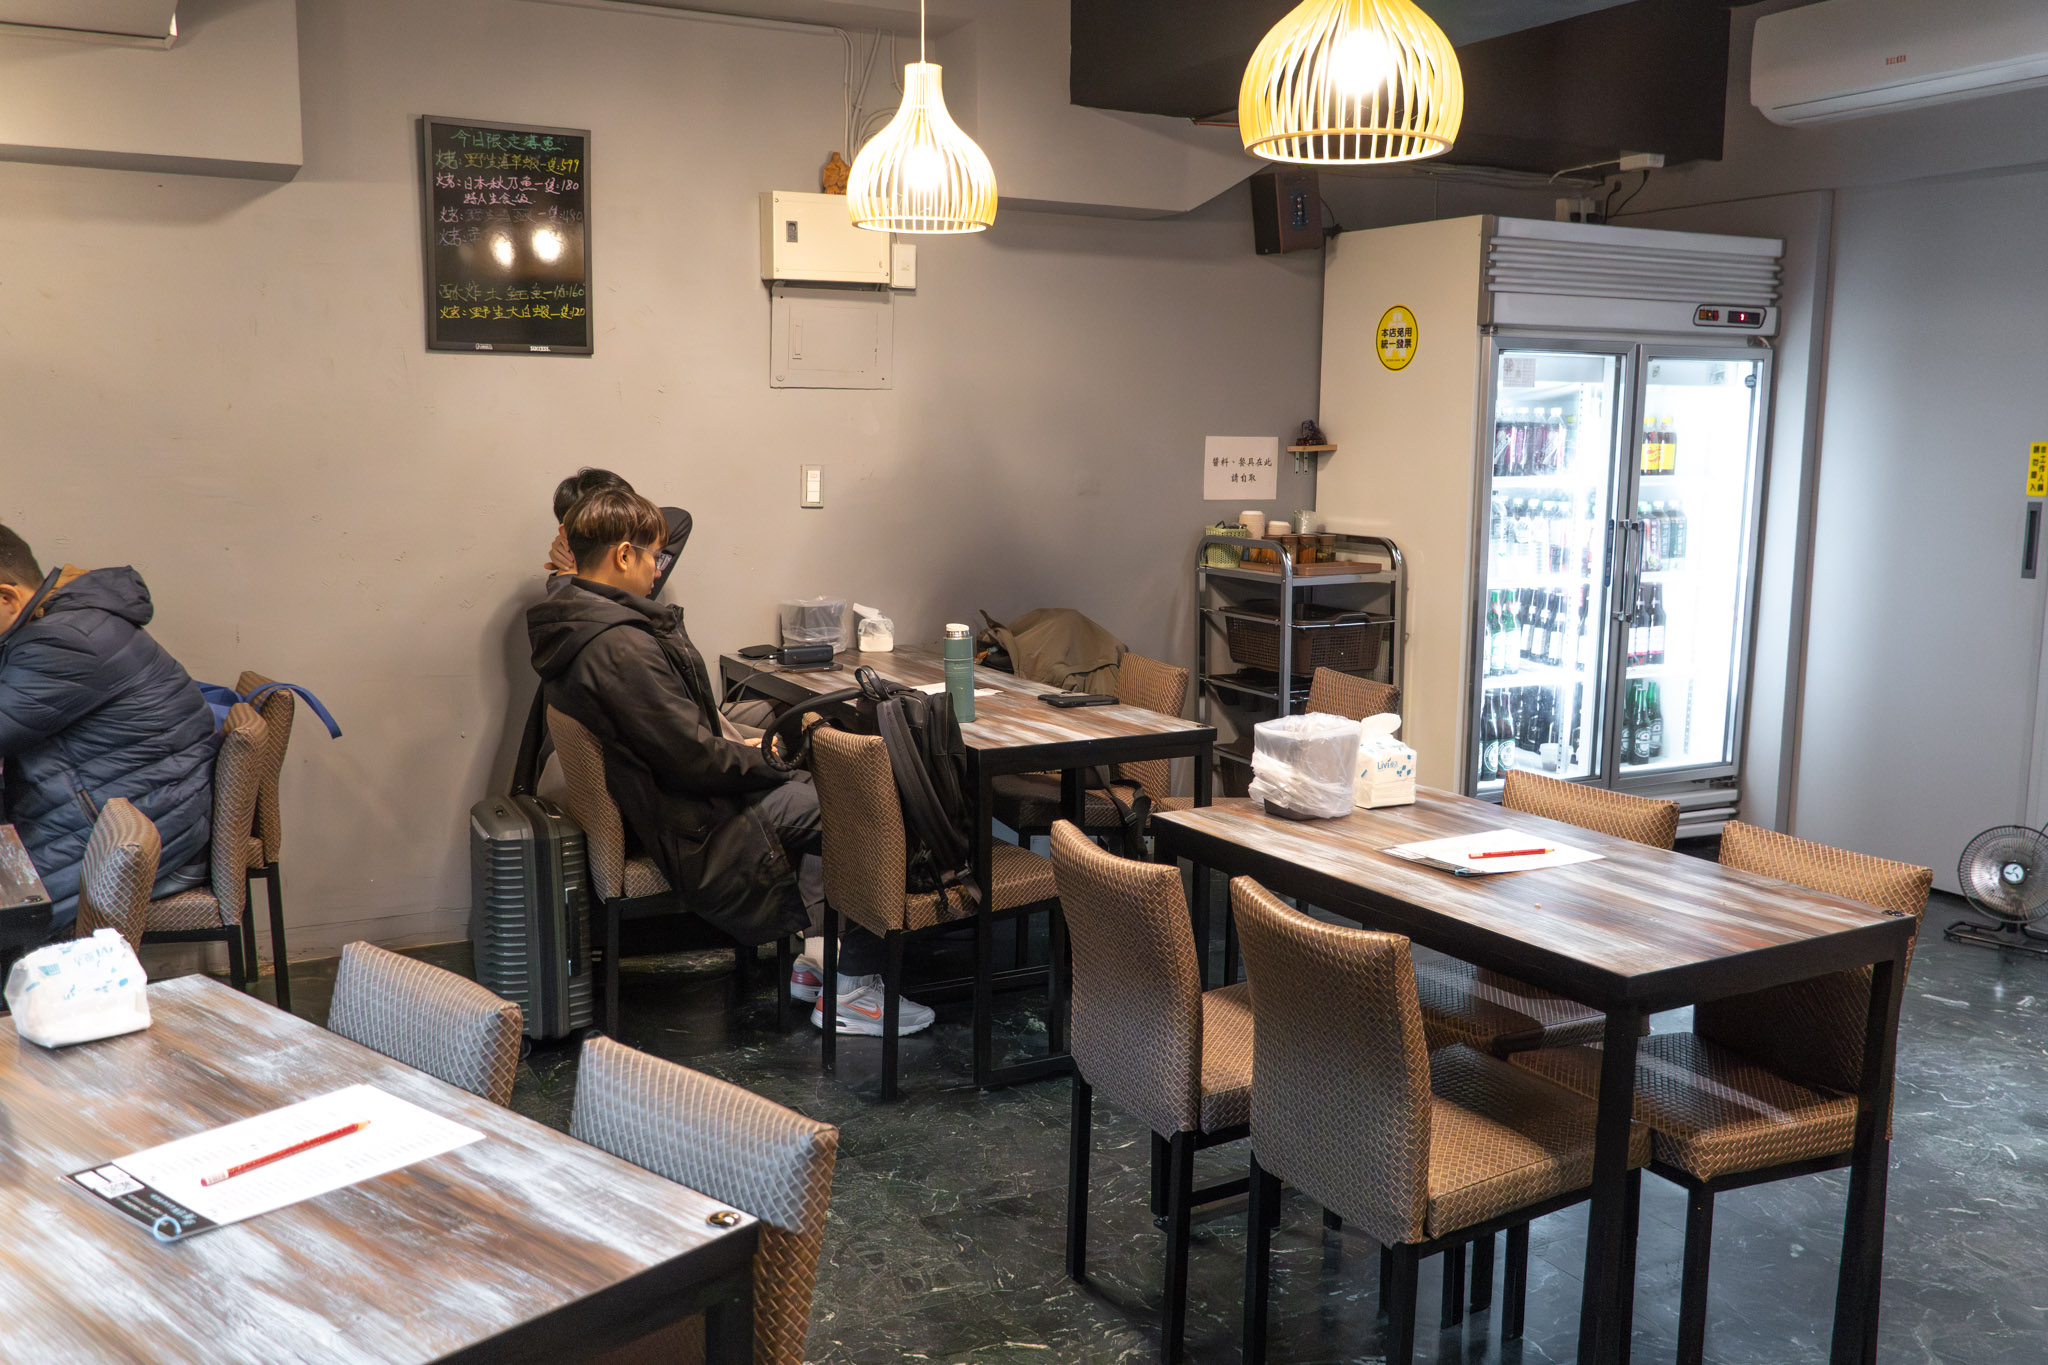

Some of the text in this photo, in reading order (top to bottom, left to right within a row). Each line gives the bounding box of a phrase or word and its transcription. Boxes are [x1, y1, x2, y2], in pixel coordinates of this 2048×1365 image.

[1381, 327, 1413, 338] 本店免用
[1381, 338, 1412, 349] 統一發票
[1212, 456, 1273, 468] 醬料、餐具在此
[1231, 472, 1257, 484] 請自取
